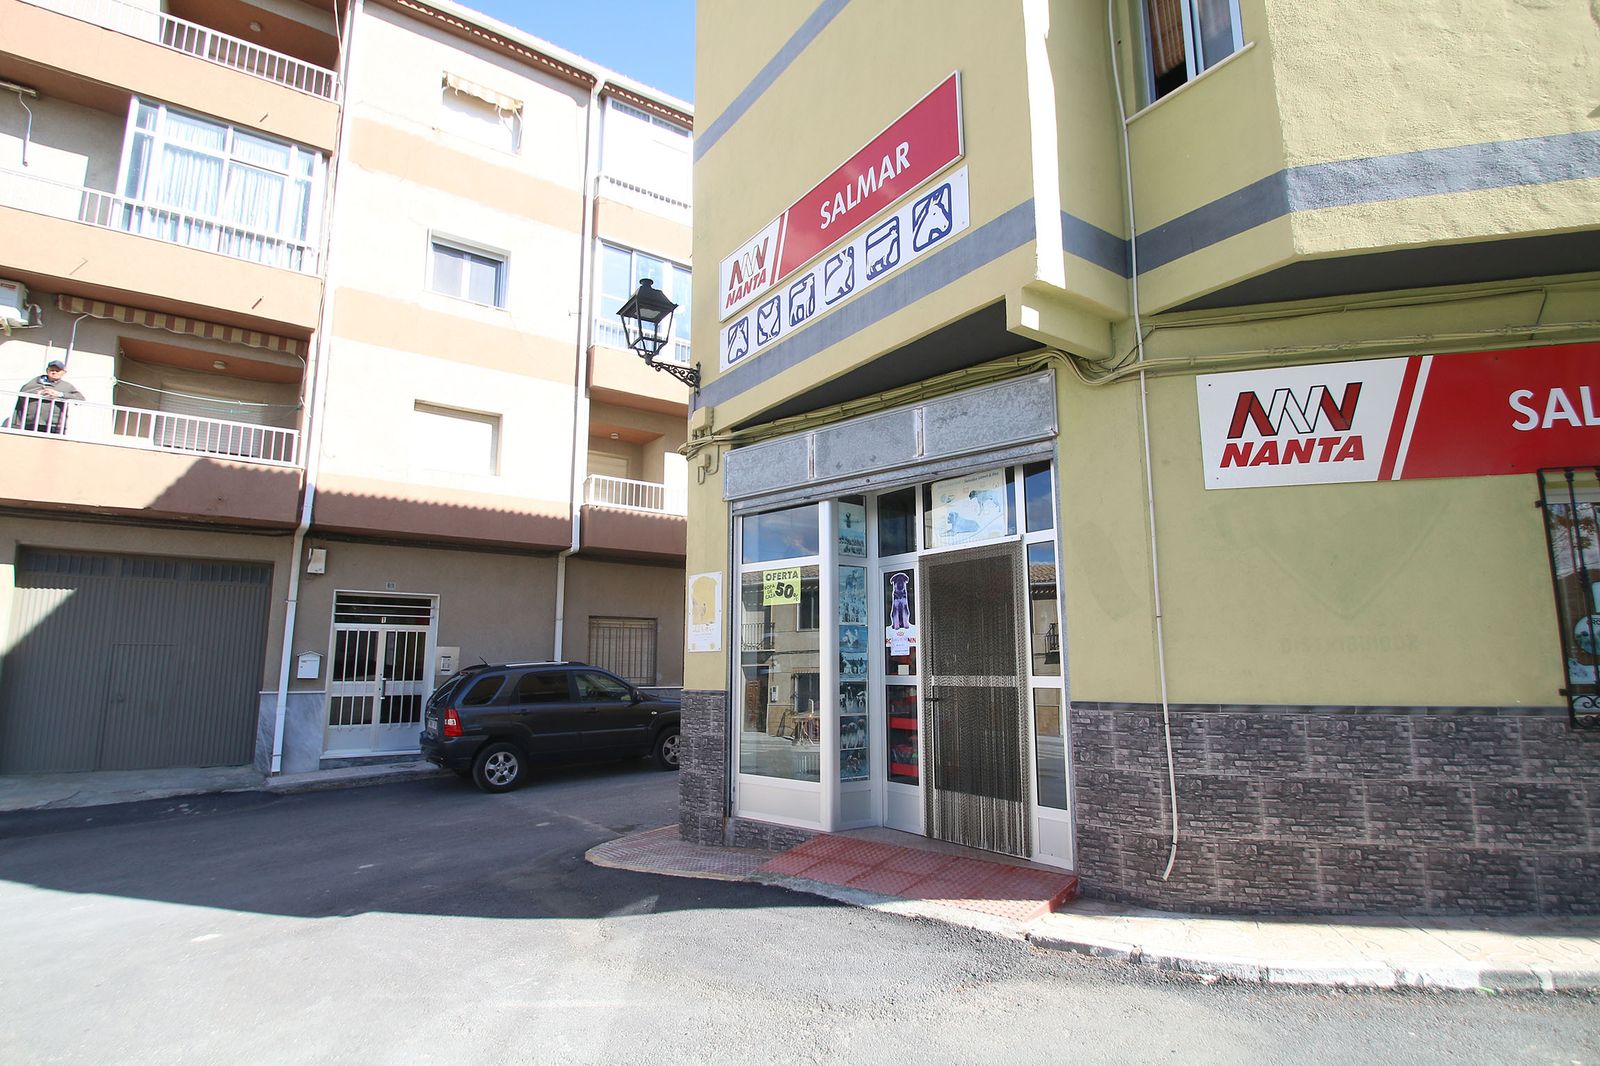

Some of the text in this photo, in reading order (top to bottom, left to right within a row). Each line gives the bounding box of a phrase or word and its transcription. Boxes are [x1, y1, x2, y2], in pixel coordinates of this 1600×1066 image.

[820, 141, 911, 229] SALMAR
[725, 268, 767, 309] NANTA
[1508, 386, 1600, 431] SAL
[1220, 435, 1365, 468] NANTA
[765, 571, 799, 581] OFERTA
